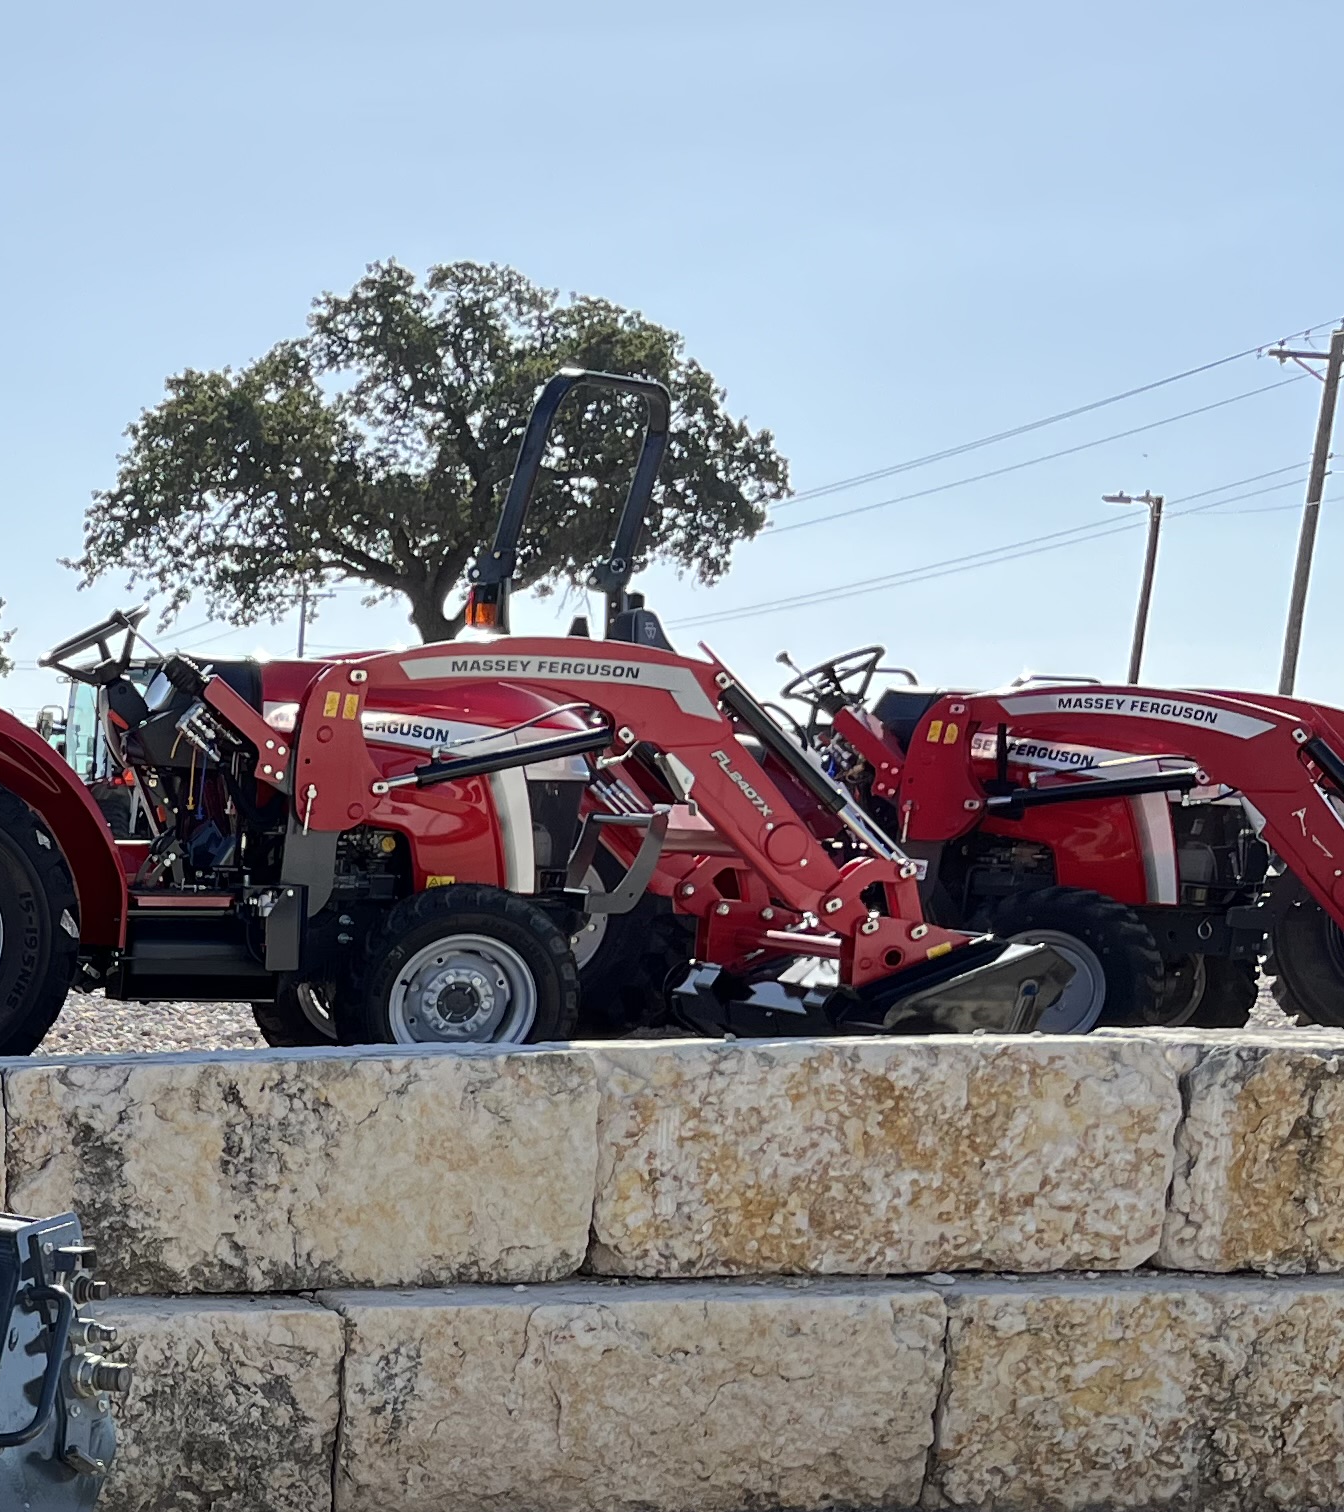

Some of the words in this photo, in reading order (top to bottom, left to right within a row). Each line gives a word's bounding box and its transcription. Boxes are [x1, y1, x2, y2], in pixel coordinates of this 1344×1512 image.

[451, 660, 531, 673] MASSEY
[537, 661, 640, 680] FERGUSON
[1057, 698, 1126, 710] MASSEY
[1129, 700, 1218, 724] FERGUSON
[364, 720, 450, 743] ERGUSON
[1006, 742, 1095, 768] FERGUSON
[710, 749, 774, 818] FL2407X
